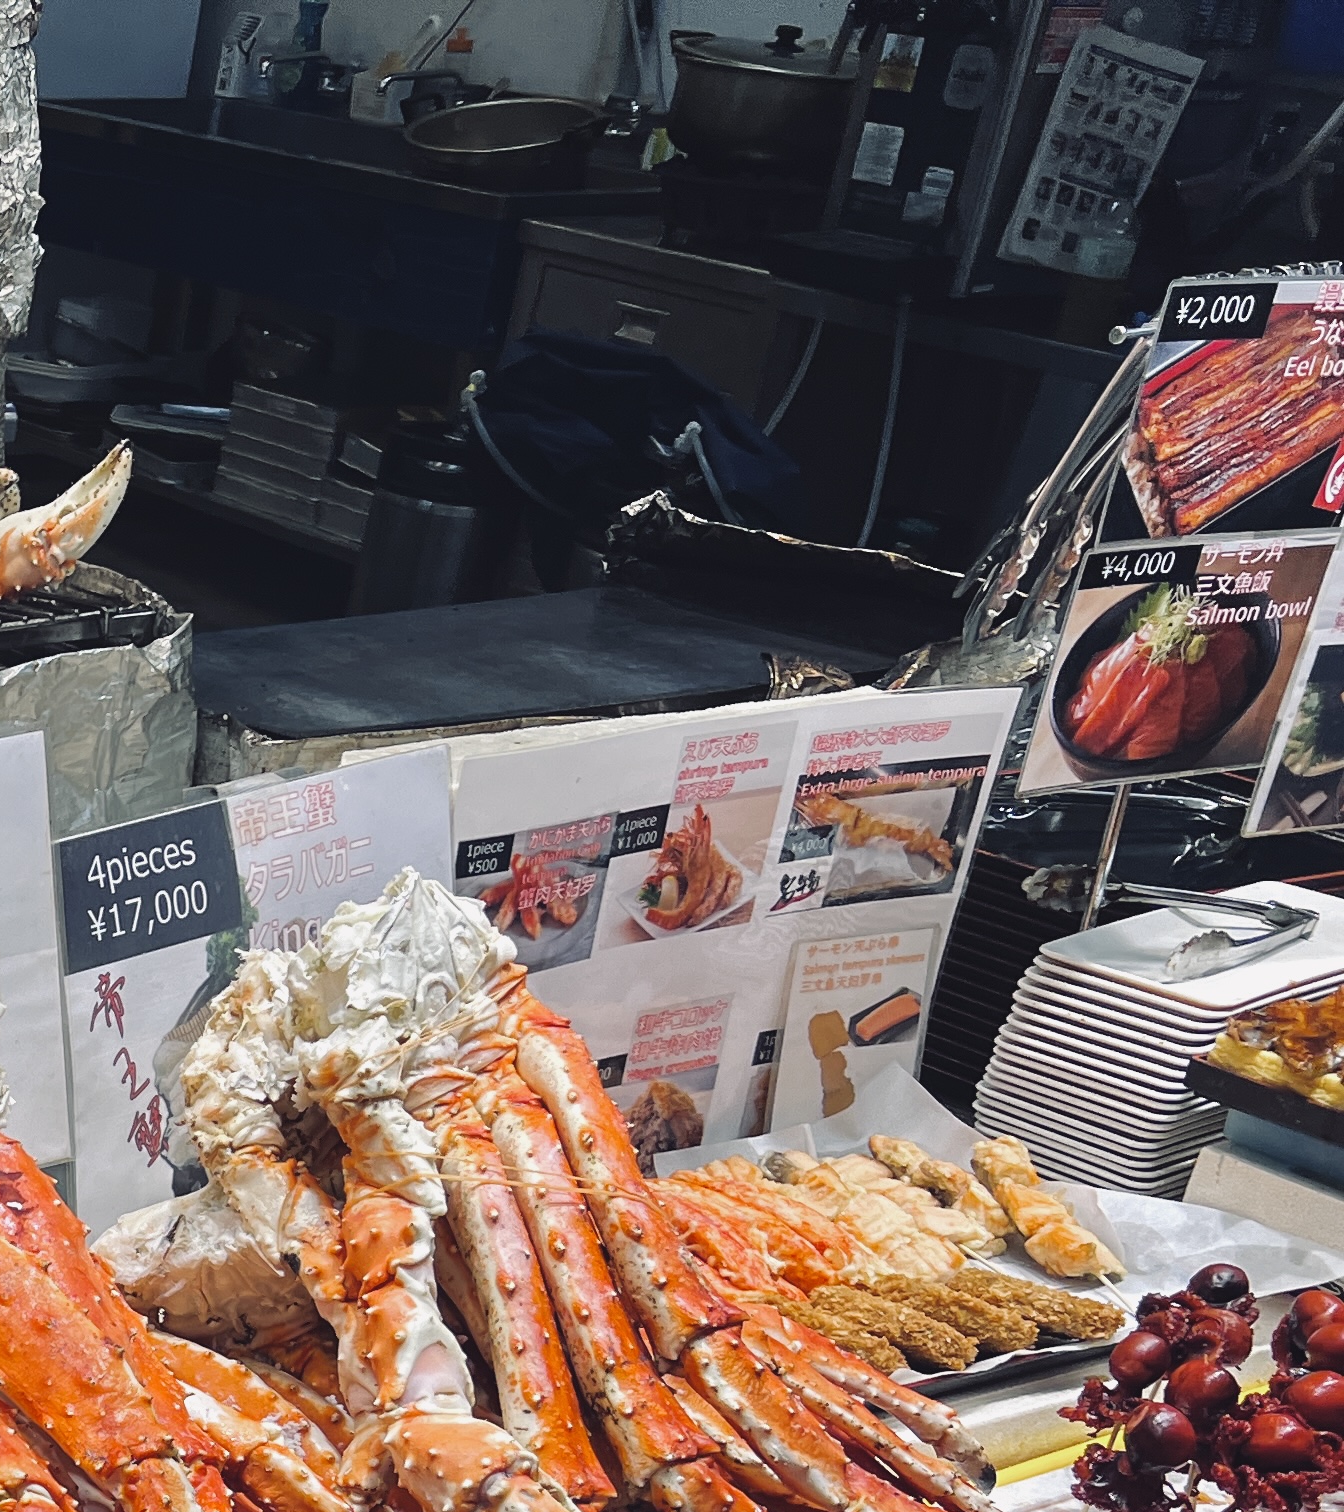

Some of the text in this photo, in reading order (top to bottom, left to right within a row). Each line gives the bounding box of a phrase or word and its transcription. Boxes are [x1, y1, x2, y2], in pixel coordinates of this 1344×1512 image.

[1176, 294, 1256, 330] ¥2,000
[1284, 355, 1317, 377] Eel
[1101, 550, 1176, 582] ¥4,000
[1183, 604, 1260, 627] Salmon
[1265, 596, 1311, 620] bowl
[800, 779, 835, 797] Extra
[928, 766, 987, 782] tempura
[233, 780, 337, 847] 帝王蟹
[466, 840, 506, 858] 1piece
[617, 830, 659, 850] ¥1,000
[86, 838, 197, 894] 4pieces
[245, 836, 374, 907] タラバガニ
[467, 857, 499, 875] ¥500
[87, 880, 208, 942] ¥17,000
